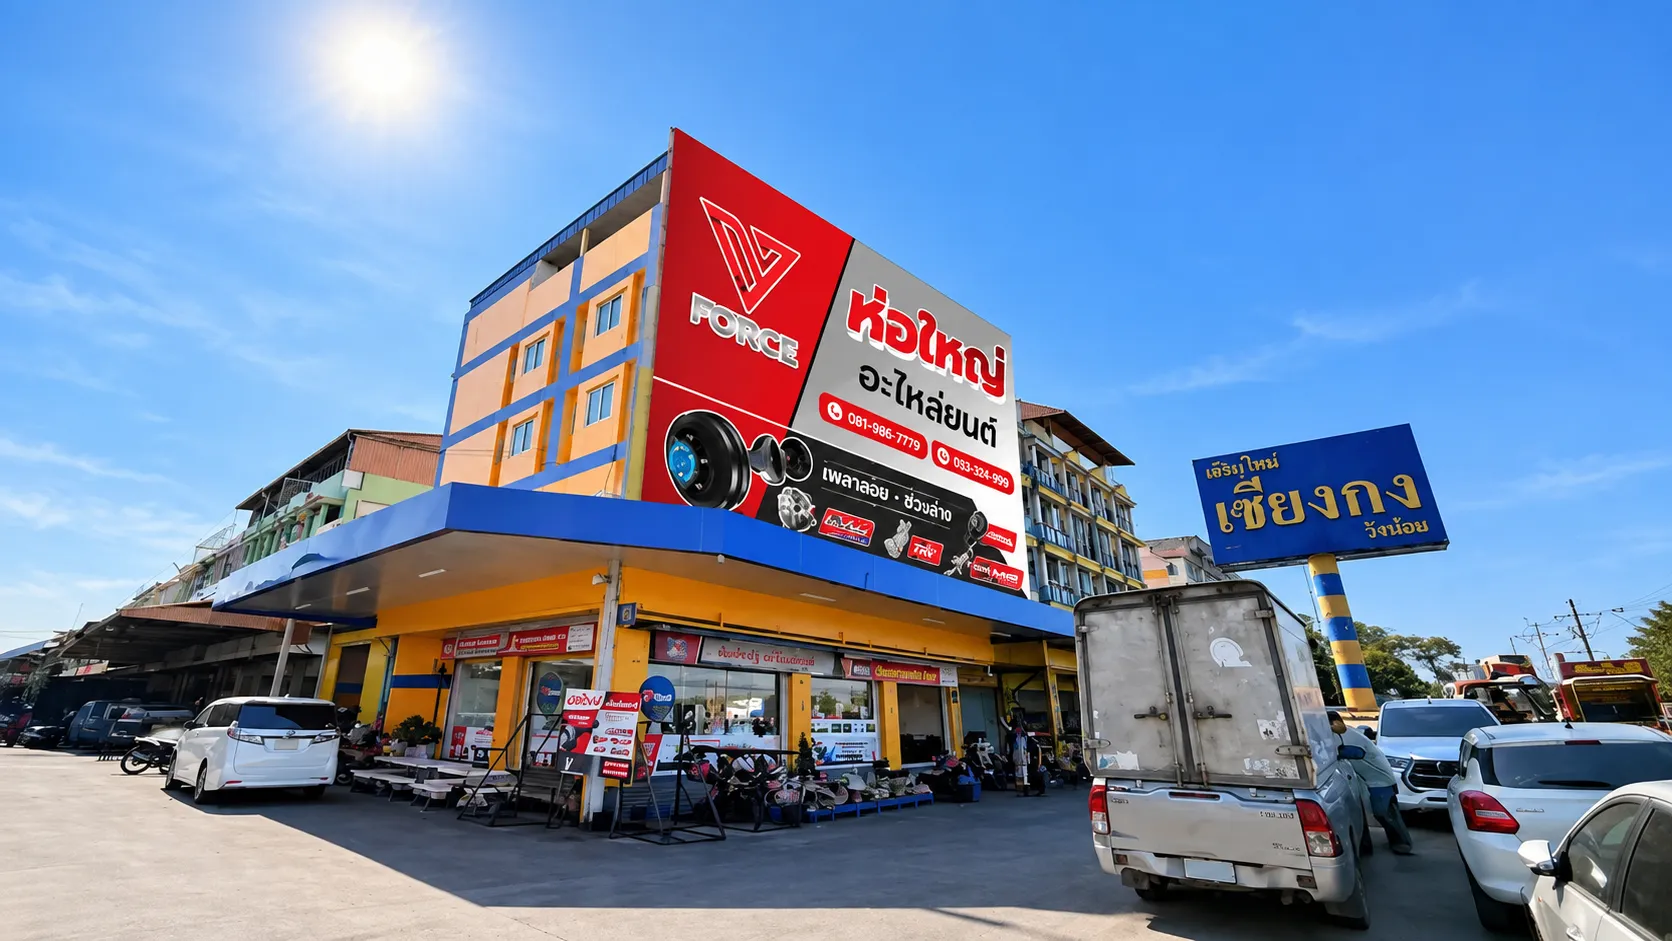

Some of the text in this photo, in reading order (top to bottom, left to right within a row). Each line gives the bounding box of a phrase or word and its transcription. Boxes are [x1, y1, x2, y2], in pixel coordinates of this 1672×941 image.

[690, 292, 799, 369] FORCE
[846, 284, 1007, 405] ห่อใหญ่
[848, 412, 921, 452] 081-986-7779
[858, 364, 998, 448] อะไหล่ยนต์
[822, 467, 889, 501] เพลาลอย
[1215, 474, 1422, 533] เซียงกง
[1364, 517, 1429, 539] วังน้อย
